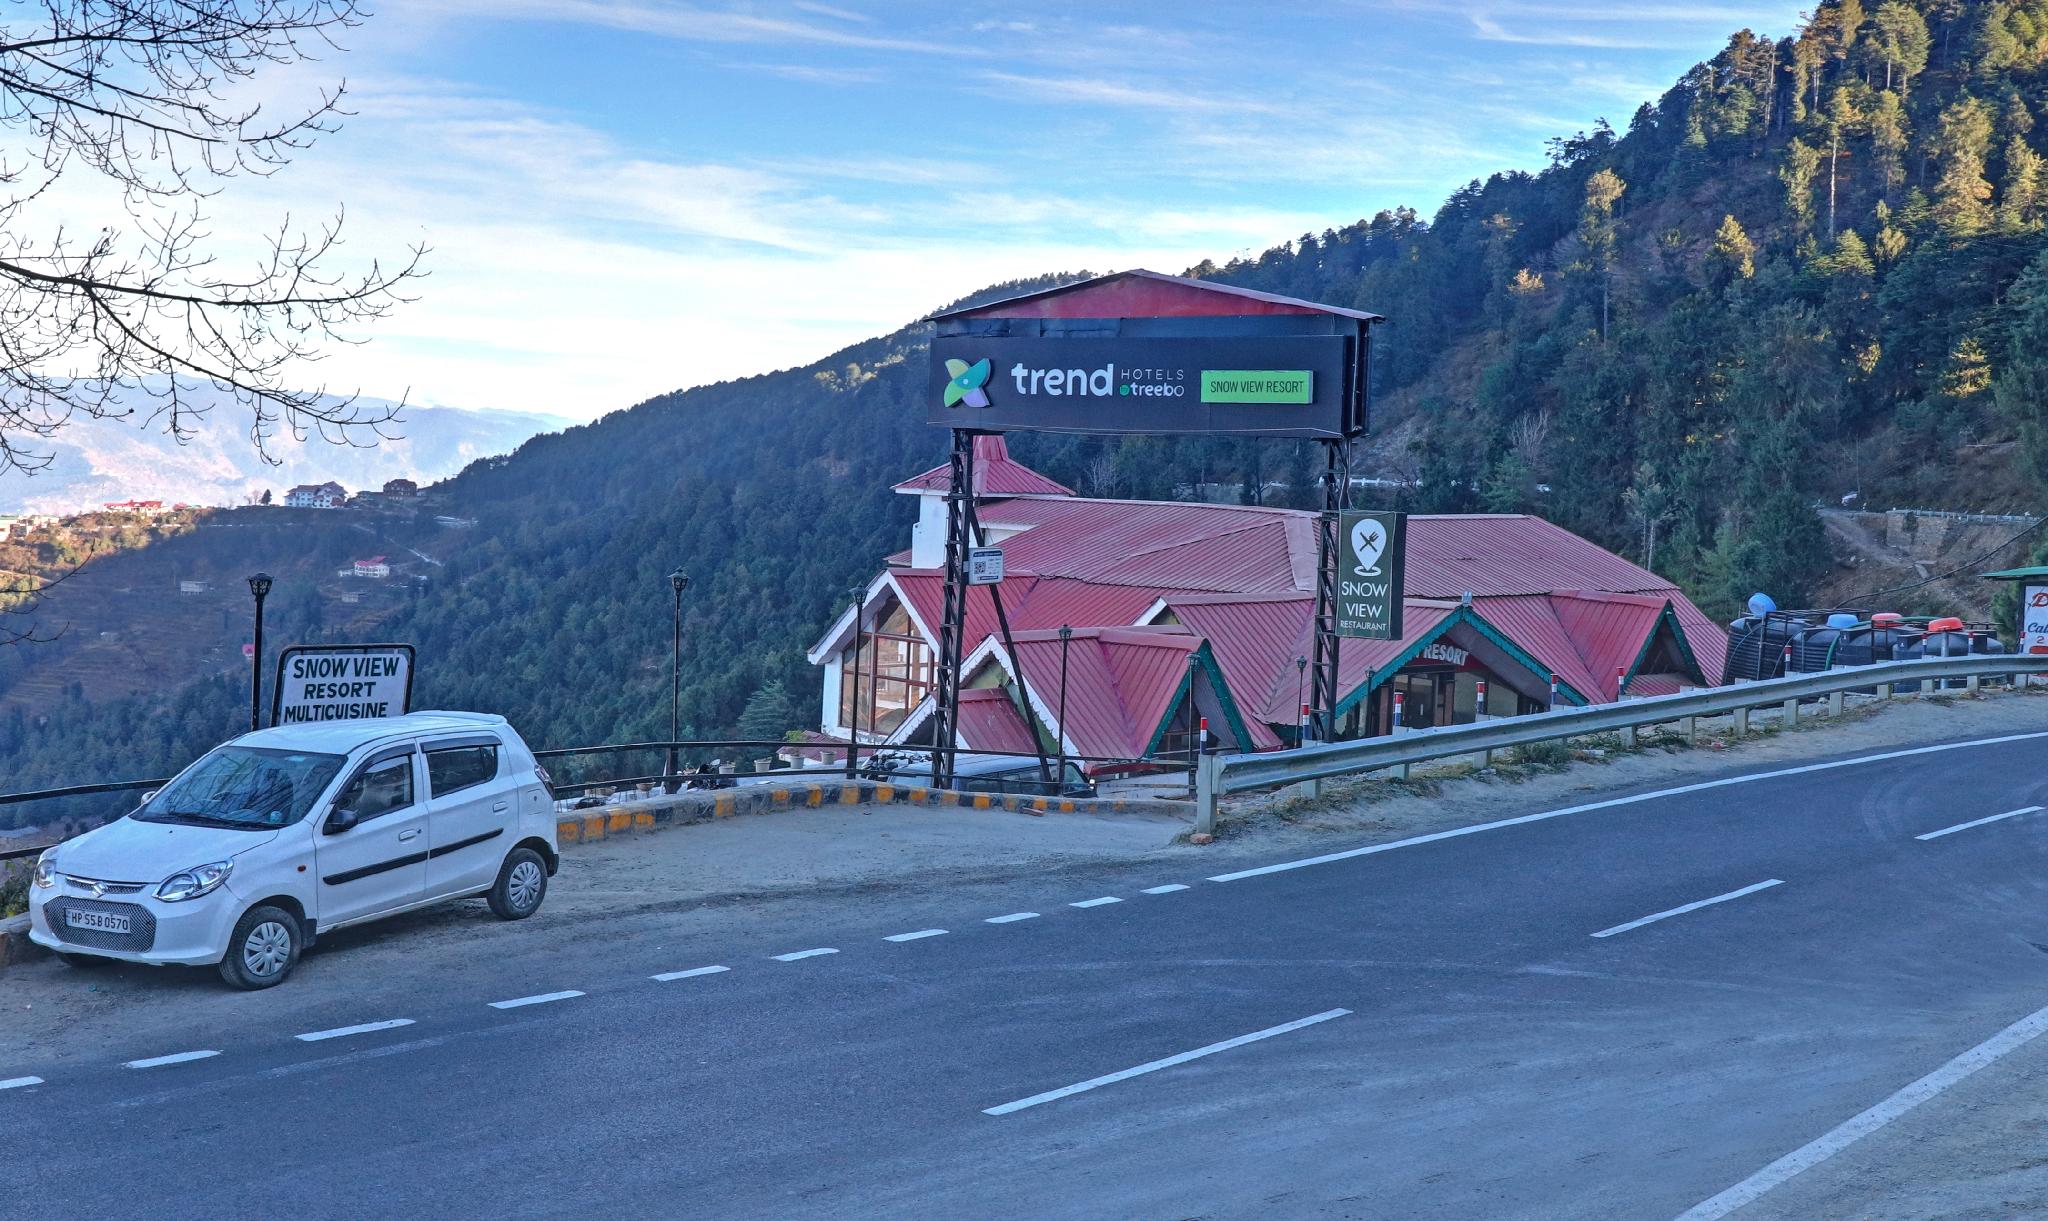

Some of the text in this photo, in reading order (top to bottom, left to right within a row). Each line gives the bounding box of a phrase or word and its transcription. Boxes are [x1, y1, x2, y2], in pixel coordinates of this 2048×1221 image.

[1011, 363, 1114, 396] trend
[1121, 368, 1184, 380] HOTELS
[1130, 382, 1185, 397] treebo
[1210, 380, 1304, 393] SNOW VIEW RESORT
[1341, 581, 1388, 597] SNOW
[1346, 602, 1383, 618] VIEW
[1340, 620, 1387, 631] RESTAURANT
[1423, 643, 1469, 666] RESORT
[293, 657, 400, 679] SNOW VIEW
[304, 681, 377, 700] RESORT
[284, 701, 389, 723] MULTICUISINE
[71, 912, 83, 923] HP
[104, 916, 129, 930] 0570
